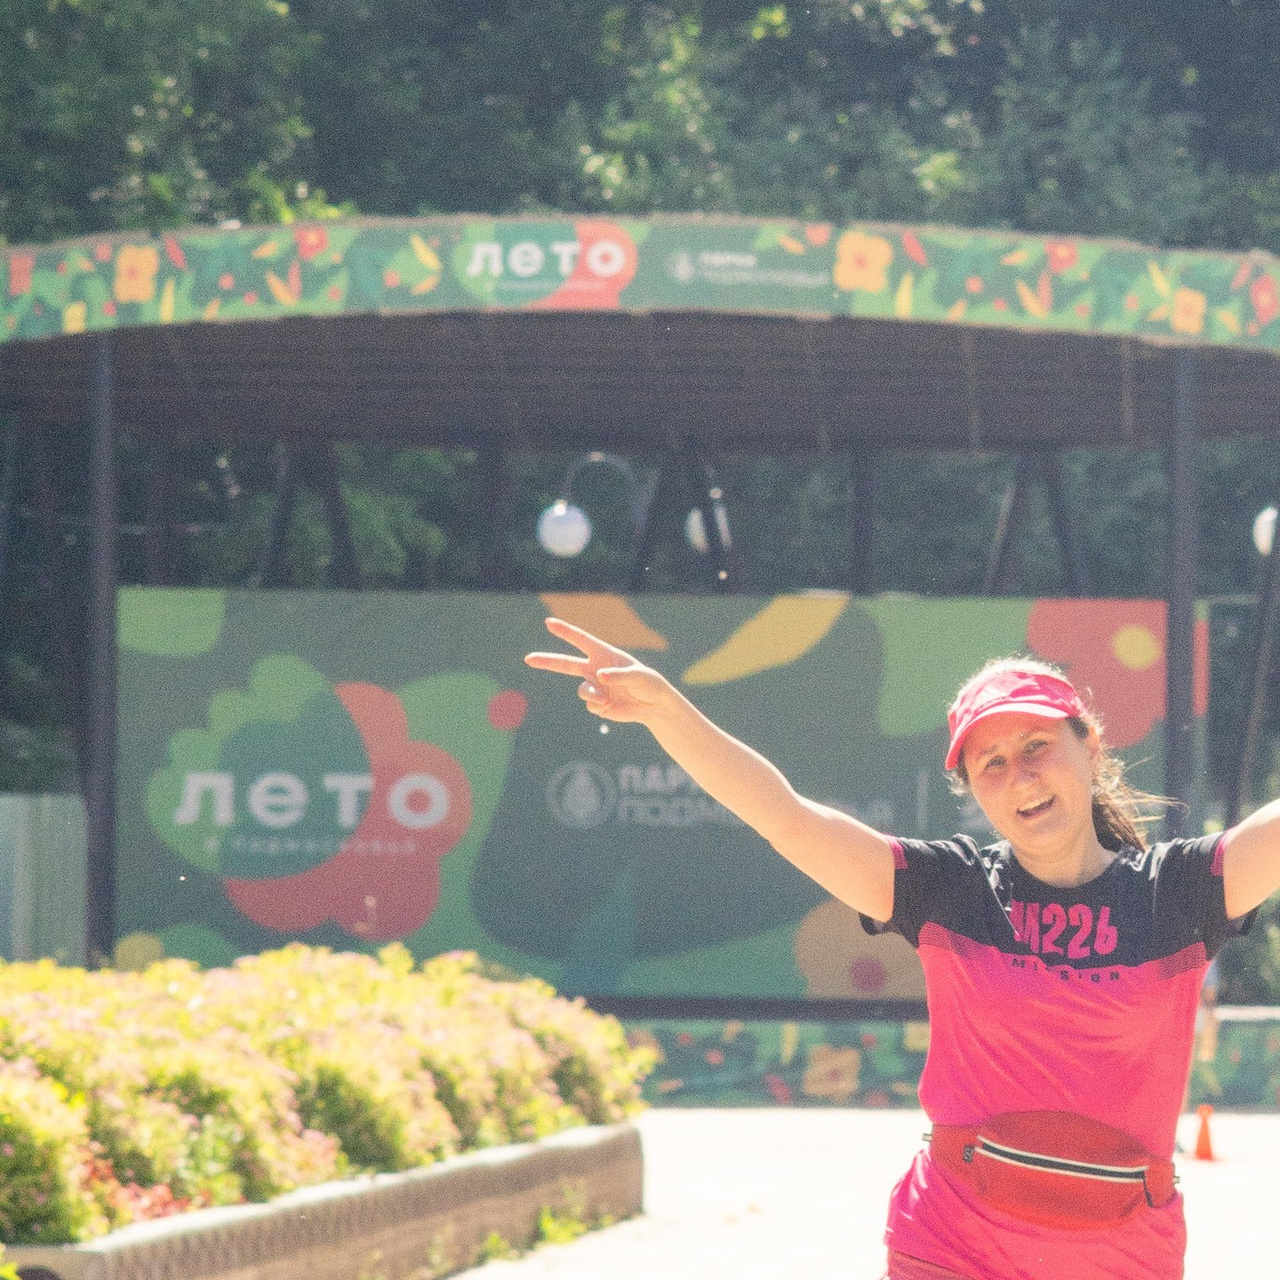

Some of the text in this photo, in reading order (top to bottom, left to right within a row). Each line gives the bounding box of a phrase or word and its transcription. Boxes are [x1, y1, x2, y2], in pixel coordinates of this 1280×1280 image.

[466, 241, 626, 278] лето
[174, 772, 449, 829] лето
[1011, 958, 1120, 983] MISION
